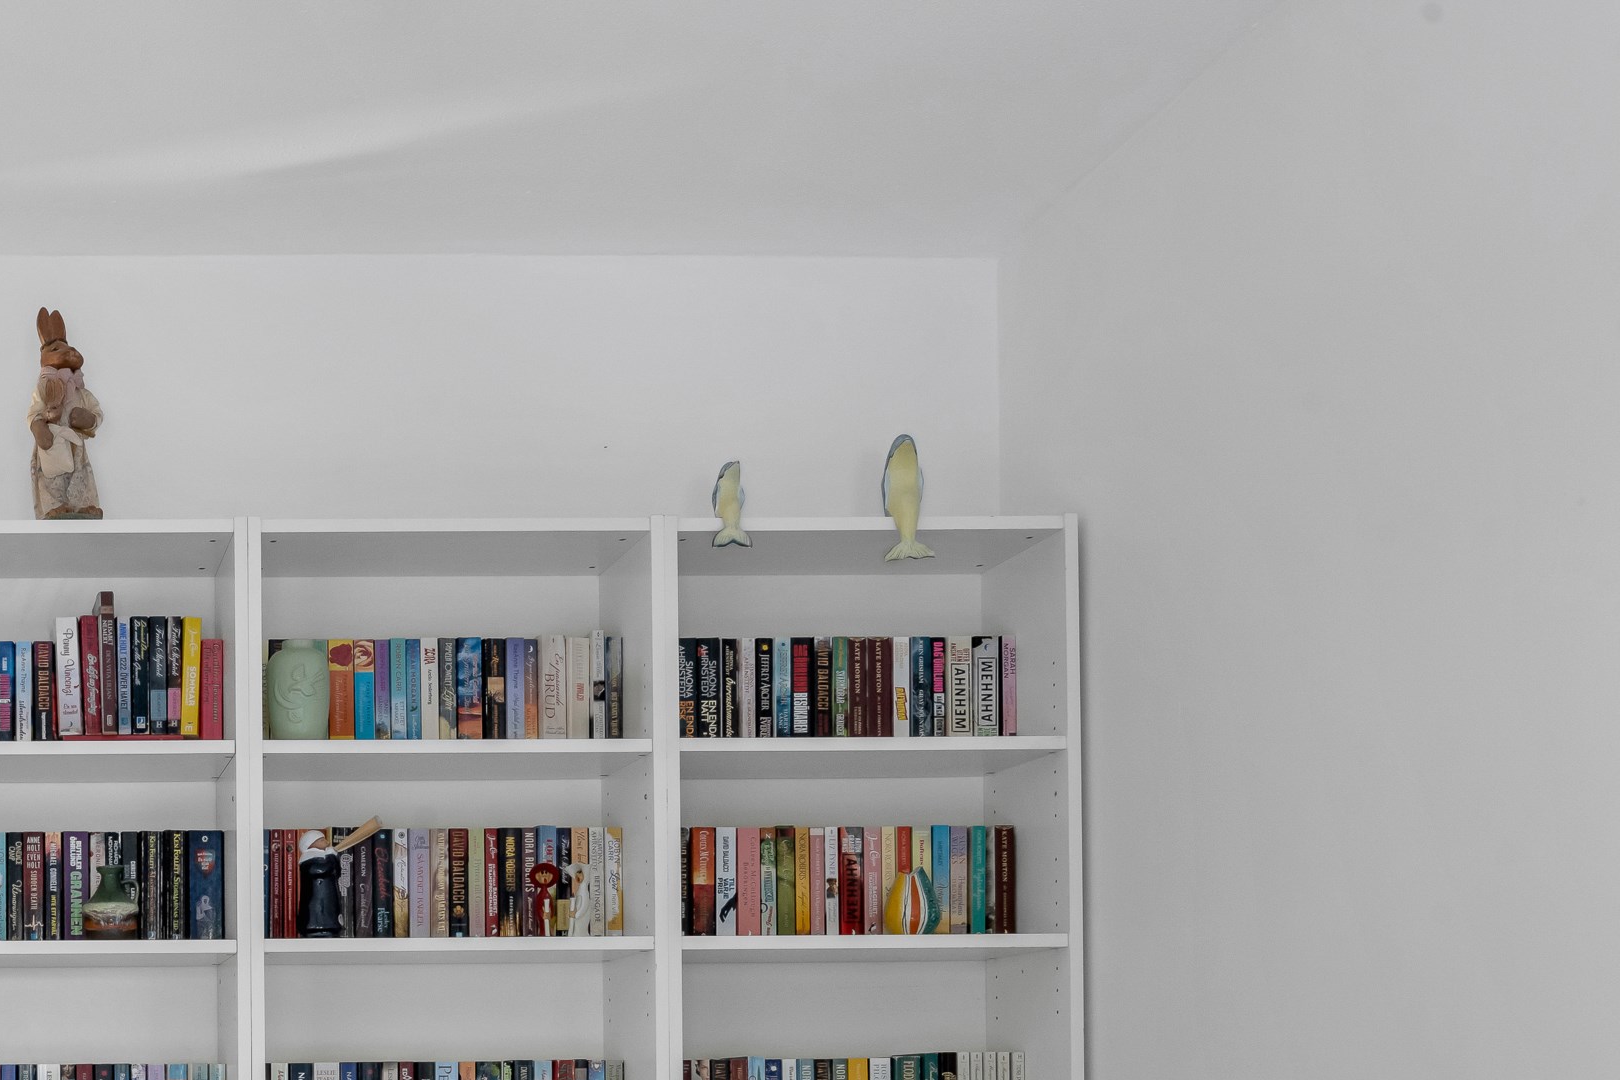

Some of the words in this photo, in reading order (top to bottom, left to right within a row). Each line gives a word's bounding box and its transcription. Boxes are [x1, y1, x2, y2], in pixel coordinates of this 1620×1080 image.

[38, 644, 50, 668] DAVID
[61, 628, 74, 656] Penny
[424, 648, 435, 664] ZORA
[759, 654, 769, 681] JEFFREY
[38, 670, 50, 710] BALDACCI
[188, 666, 196, 706] SOMMAR
[544, 673, 555, 718] BRUD
[761, 683, 769, 710] ARCHER
[817, 669, 828, 710] BALDACCI
[709, 701, 716, 713] EN
[794, 693, 809, 733] BESÖKAREN
[452, 831, 465, 857] DAVID
[506, 837, 515, 857] NORA
[525, 832, 534, 853] NORA
[453, 860, 465, 903] BALDACCI
[506, 859, 515, 891] ROBERTS
[70, 871, 82, 935] GRANNEN
